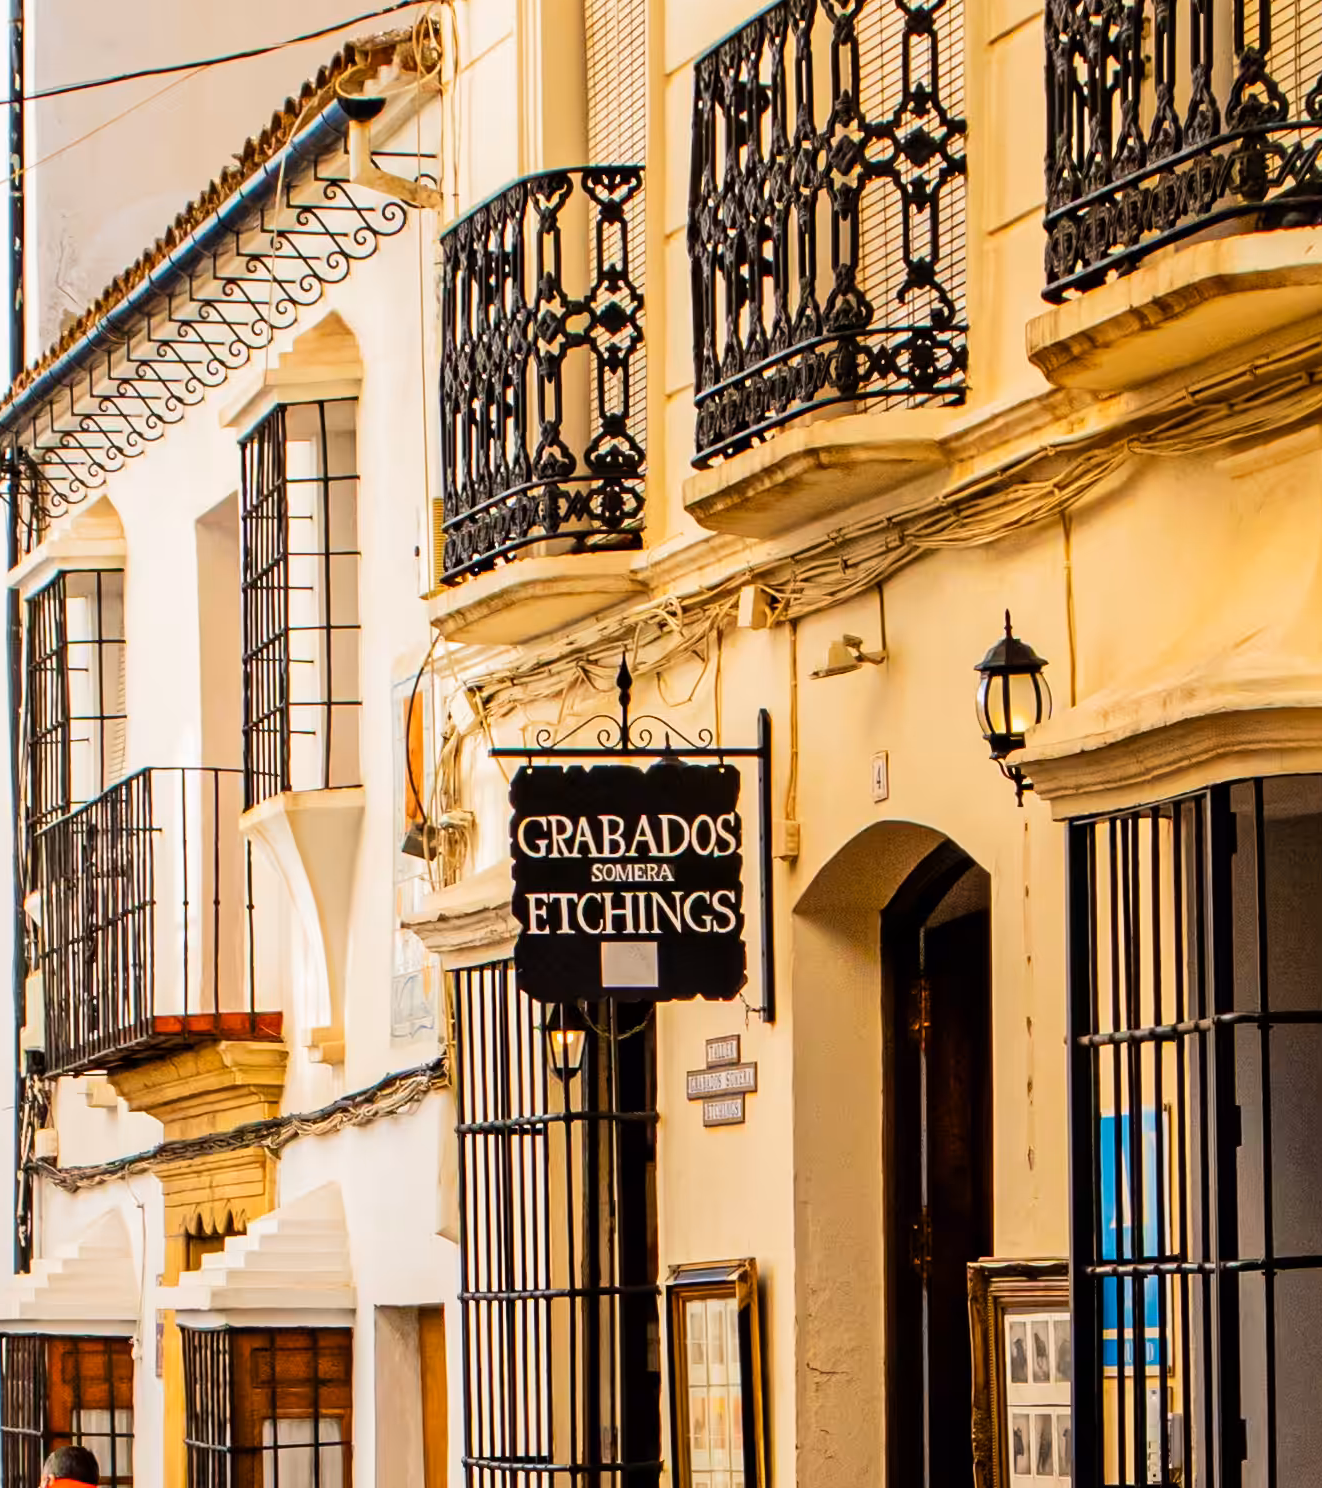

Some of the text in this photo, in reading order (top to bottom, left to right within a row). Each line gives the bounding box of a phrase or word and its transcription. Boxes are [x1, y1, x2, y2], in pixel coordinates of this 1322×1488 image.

[517, 812, 737, 858] GRABADOS
[591, 863, 675, 882] SOMERA
[525, 890, 737, 935] ETCHINGS
[690, 1074, 722, 1092] GRABADOS
